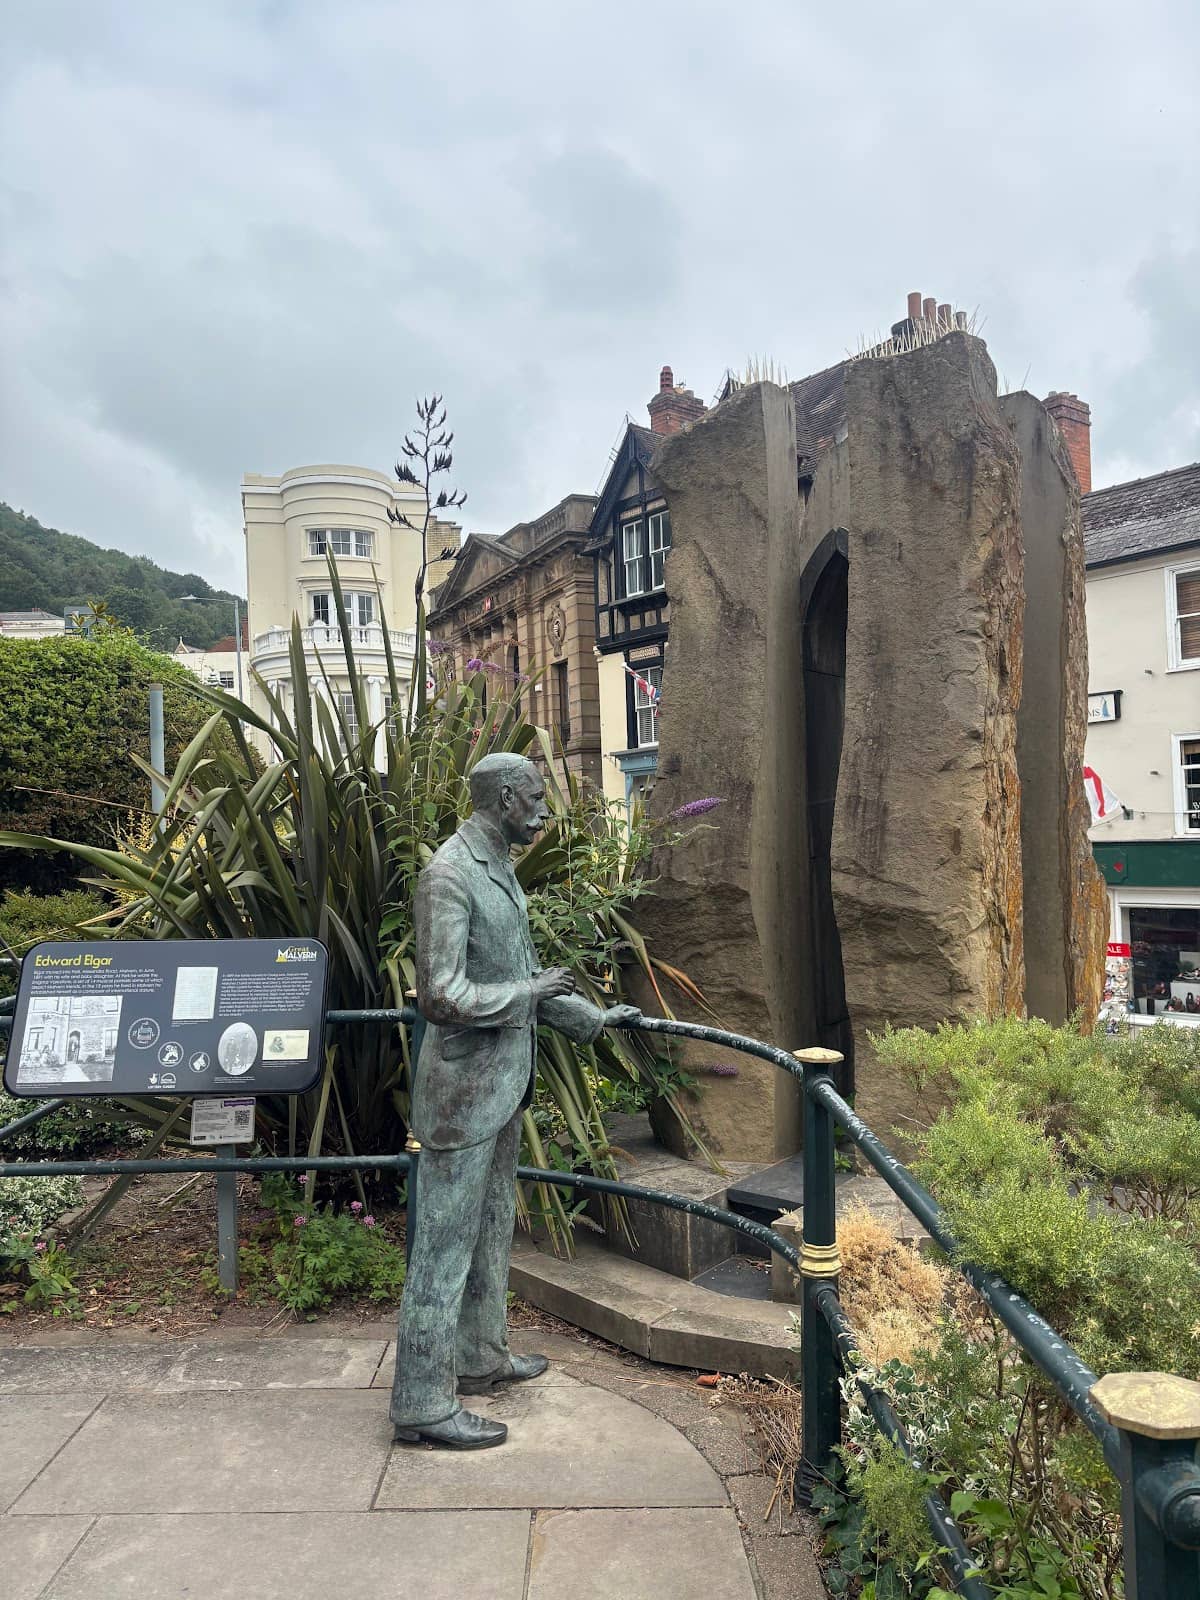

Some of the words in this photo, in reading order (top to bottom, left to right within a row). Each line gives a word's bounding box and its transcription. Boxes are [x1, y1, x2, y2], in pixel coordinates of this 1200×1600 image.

[1088, 708, 1100, 717] MS
[278, 948, 317, 959] MALVERN
[35, 955, 81, 966] Edward
[84, 954, 113, 968] Elgar
